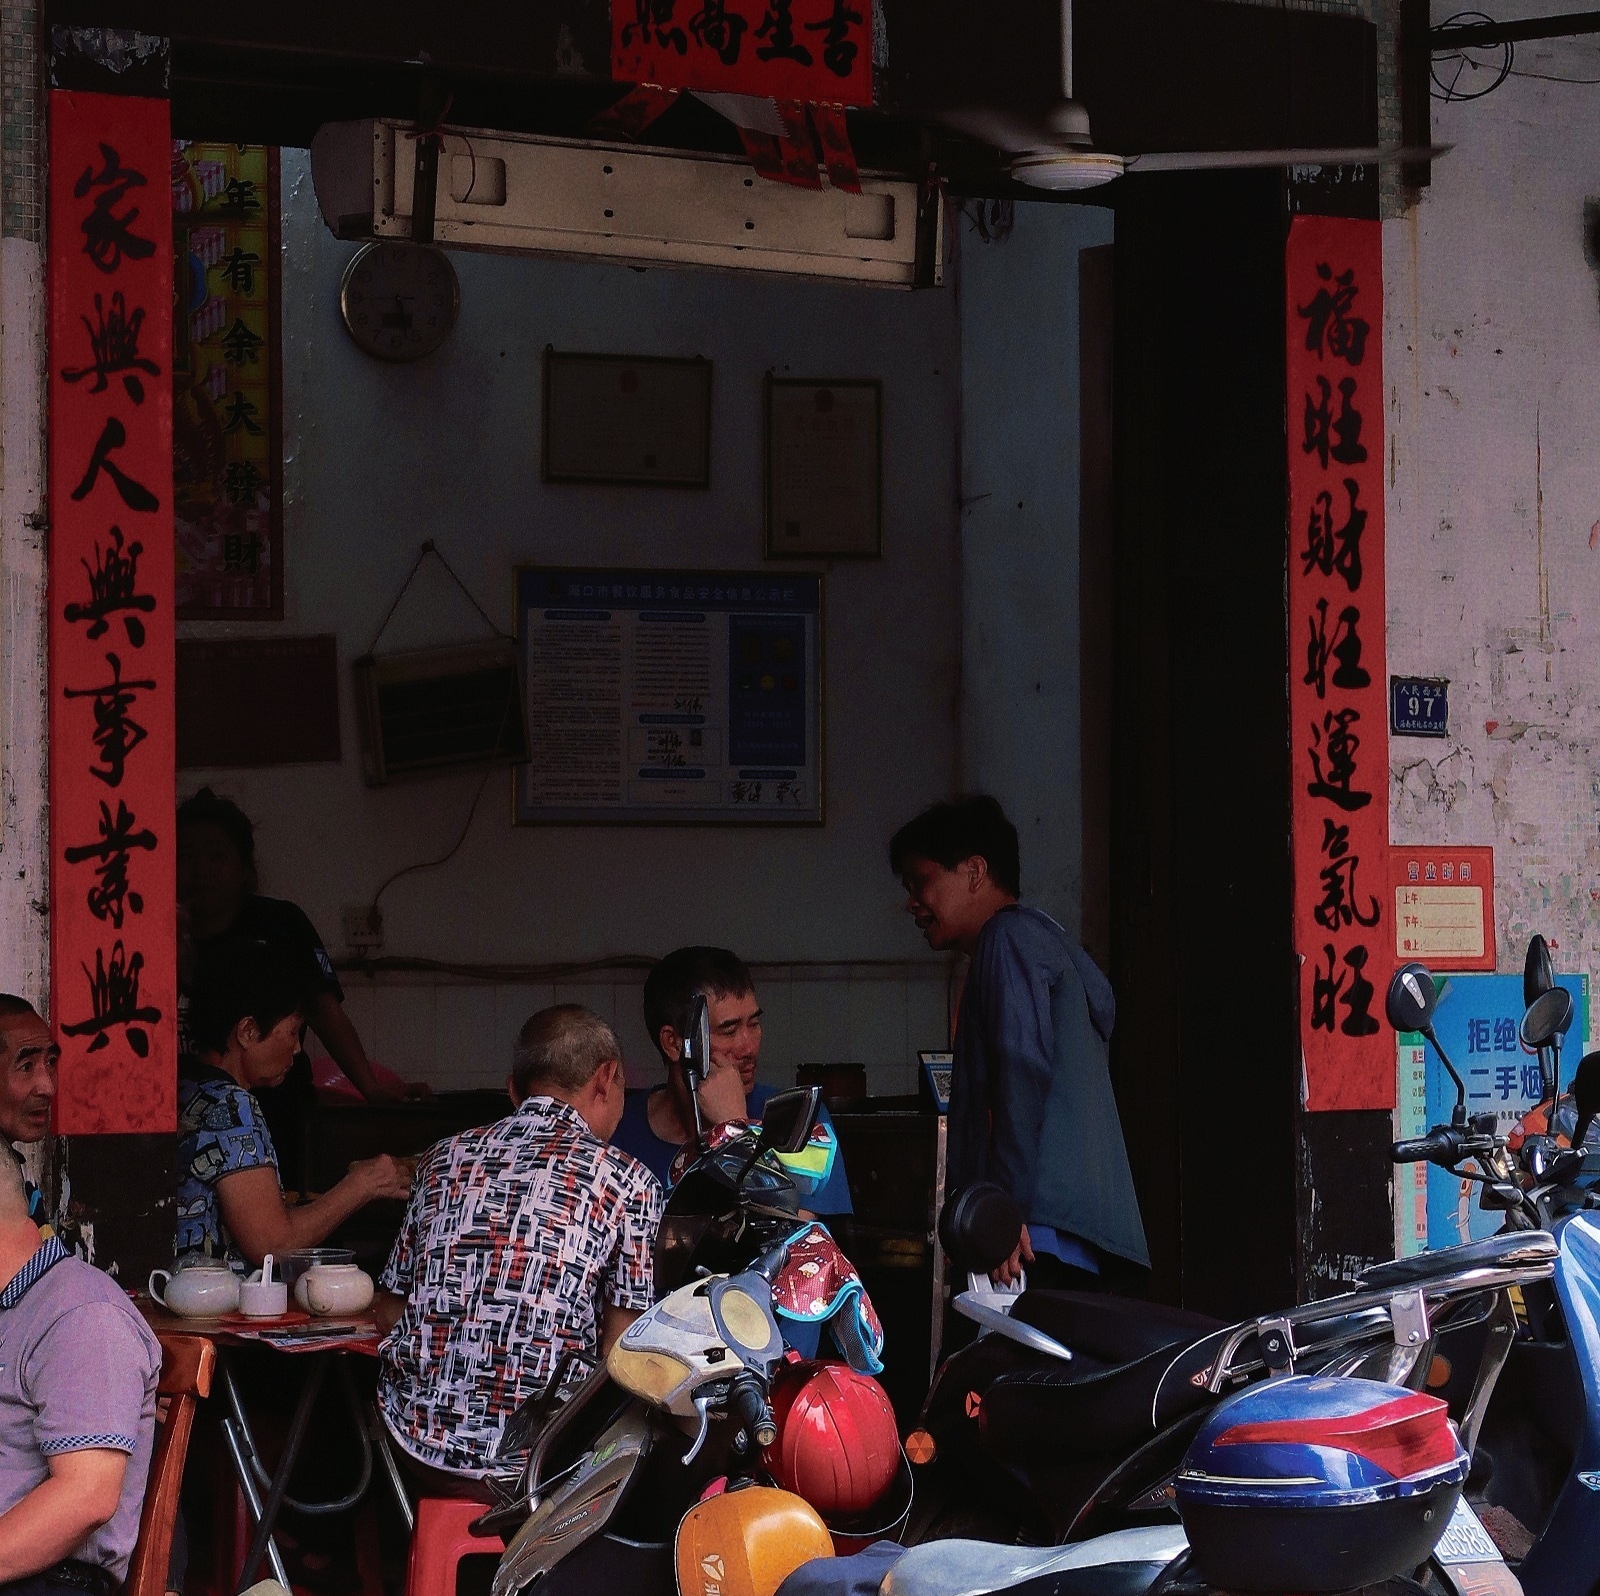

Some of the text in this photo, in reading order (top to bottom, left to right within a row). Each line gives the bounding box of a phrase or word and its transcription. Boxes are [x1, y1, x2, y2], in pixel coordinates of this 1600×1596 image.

[220, 143, 265, 575] 年有余大發財
[1408, 697, 1434, 717] 97
[1407, 860, 1472, 881] 营业时间
[1467, 1018, 1517, 1054] 拒绝
[1468, 1064, 1544, 1101] 二手烟
